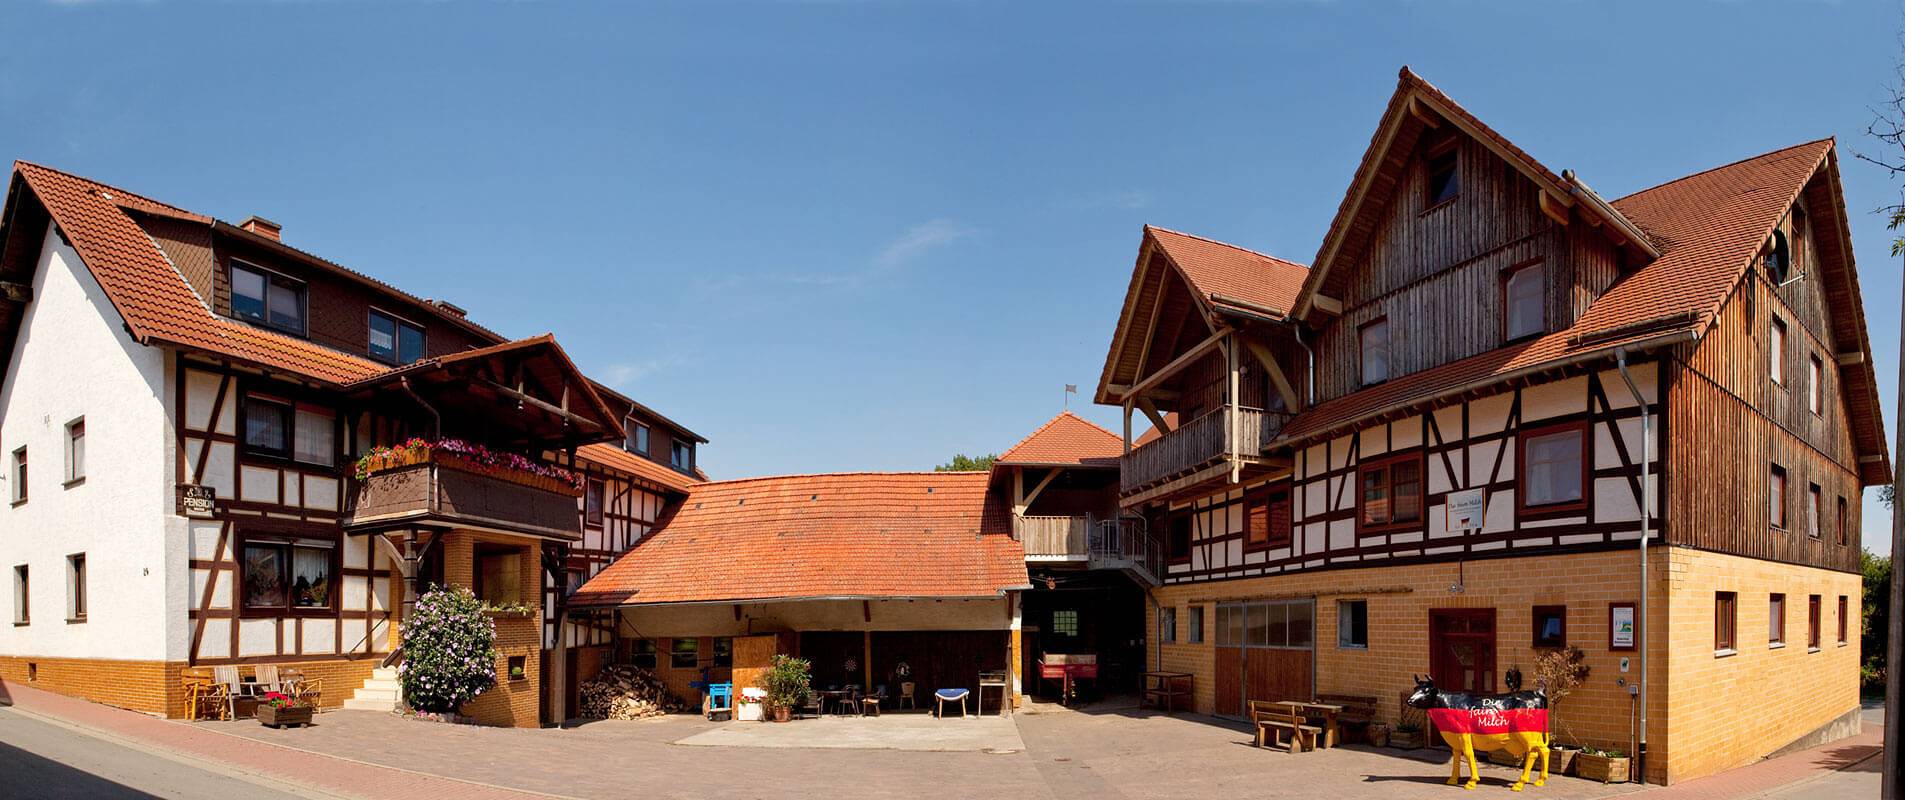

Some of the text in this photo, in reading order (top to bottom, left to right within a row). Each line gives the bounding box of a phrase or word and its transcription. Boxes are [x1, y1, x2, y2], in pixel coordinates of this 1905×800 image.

[184, 497, 214, 508] PENSION
[1482, 699, 1502, 707] Die
[1478, 716, 1509, 727] Milch
